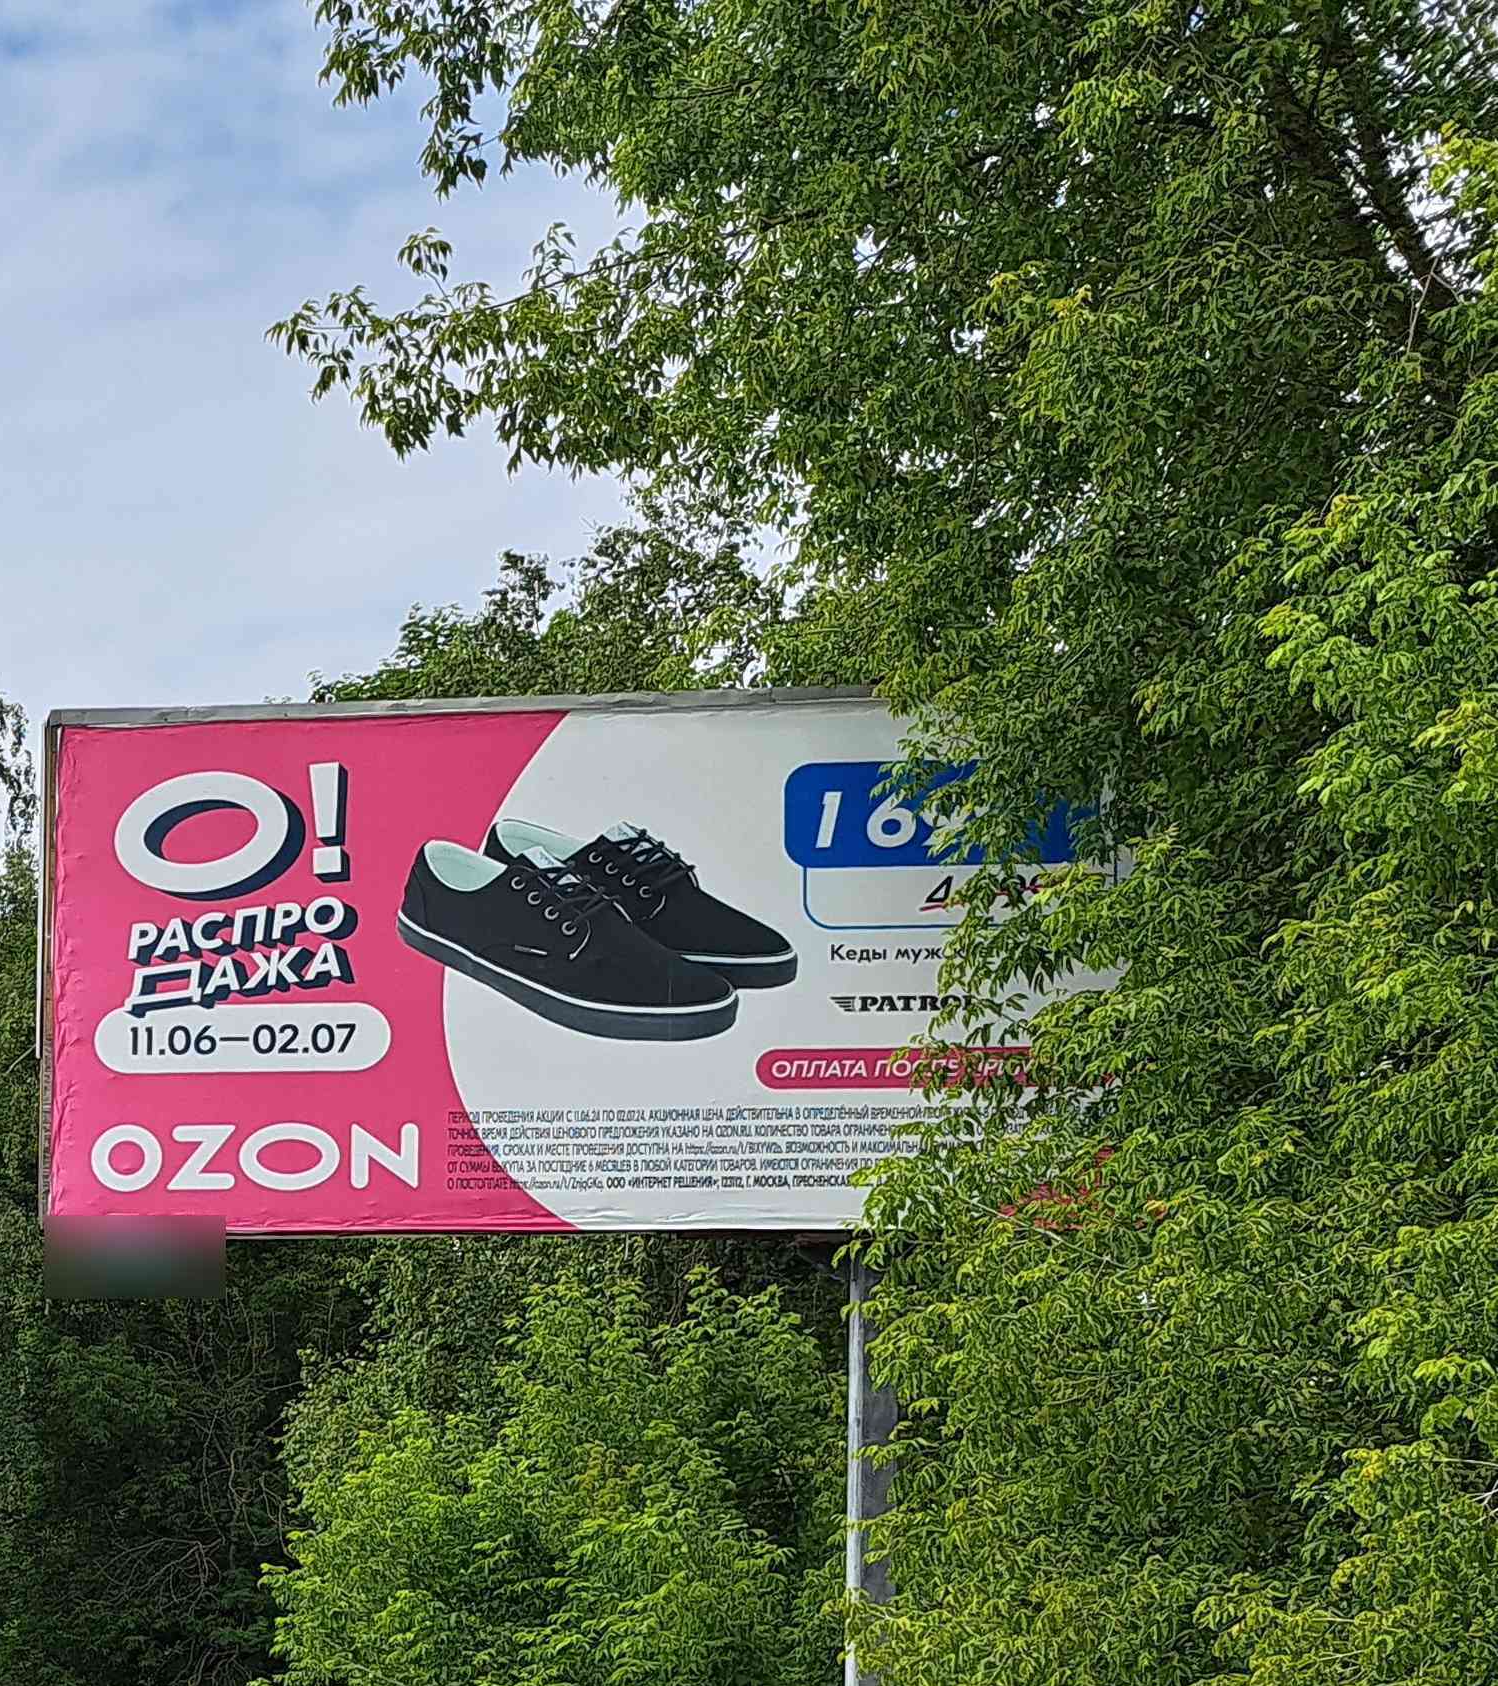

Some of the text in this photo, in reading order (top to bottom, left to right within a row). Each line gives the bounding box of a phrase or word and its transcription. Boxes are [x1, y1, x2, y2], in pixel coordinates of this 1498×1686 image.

[128, 897, 355, 963] РАСПРО
[829, 944, 886, 962] Кеды
[124, 943, 355, 1017] ДАЖА
[129, 1023, 357, 1056] 11.06—02.07
[771, 1058, 868, 1079] ОПЛАТА
[482, 1110, 534, 1123] ПРОВЕДЕНИЯ
[537, 1110, 564, 1124] АКЦИИ
[603, 1109, 615, 1121] ПО
[649, 1108, 700, 1121] АКЦИОННАЯ
[702, 1108, 723, 1121] ЦЕНА
[726, 1105, 793, 1121] ДЕЙСТВИТЕЛЬНА
[871, 1104, 921, 1119] ВРЕМЕННОЙ
[448, 1127, 480, 1139] ТОЧНОЕ
[482, 1127, 507, 1139] ВРЕМЯ
[509, 1125, 550, 1140] ДЕЙСТВИЯ
[553, 1126, 596, 1139] ЦЕНОВОГО
[598, 1126, 659, 1139] ПРЕДЛОЖЕНИЯ
[661, 1125, 700, 1138] УКАЗАНО
[702, 1125, 713, 1137] НА
[755, 1124, 808, 1137] КОЛИЧЕСТВО
[811, 1124, 841, 1137] ТОВАРА
[91, 1122, 420, 1192] OZON
[503, 1143, 535, 1156] СРОКАХ
[545, 1143, 570, 1155] МЕСТЕ
[572, 1142, 624, 1155] ПРОВЕДЕНИЯ
[626, 1142, 669, 1156] ДОСТУПНА
[672, 1142, 683, 1154] НА
[785, 1140, 850, 1153] ВОЗМОЖНОСТЬ
[448, 1161, 457, 1173] ОТ
[459, 1161, 489, 1173] СУММЫ
[491, 1160, 524, 1173] ВЫКУПА
[526, 1160, 536, 1172] ЗА
[538, 1160, 586, 1173] ПОСЛЕДНИЕ
[595, 1159, 631, 1172] МЕСЯЦЕВ
[641, 1156, 670, 1171] ЛЮБОЙ
[673, 1158, 717, 1171] КАТЕГОРИИ
[760, 1157, 799, 1170] ИМЕЮТСЯ
[801, 1157, 858, 1170] ОГРАНИЧЕНИЯ
[447, 1177, 454, 1190] О
[456, 1176, 507, 1190] ПОСТОПЛАТЕ
[606, 1176, 626, 1189] ООО
[629, 1176, 671, 1189] «ИНТЕРНЕТ
[753, 1174, 790, 1189] МОСКВА,
